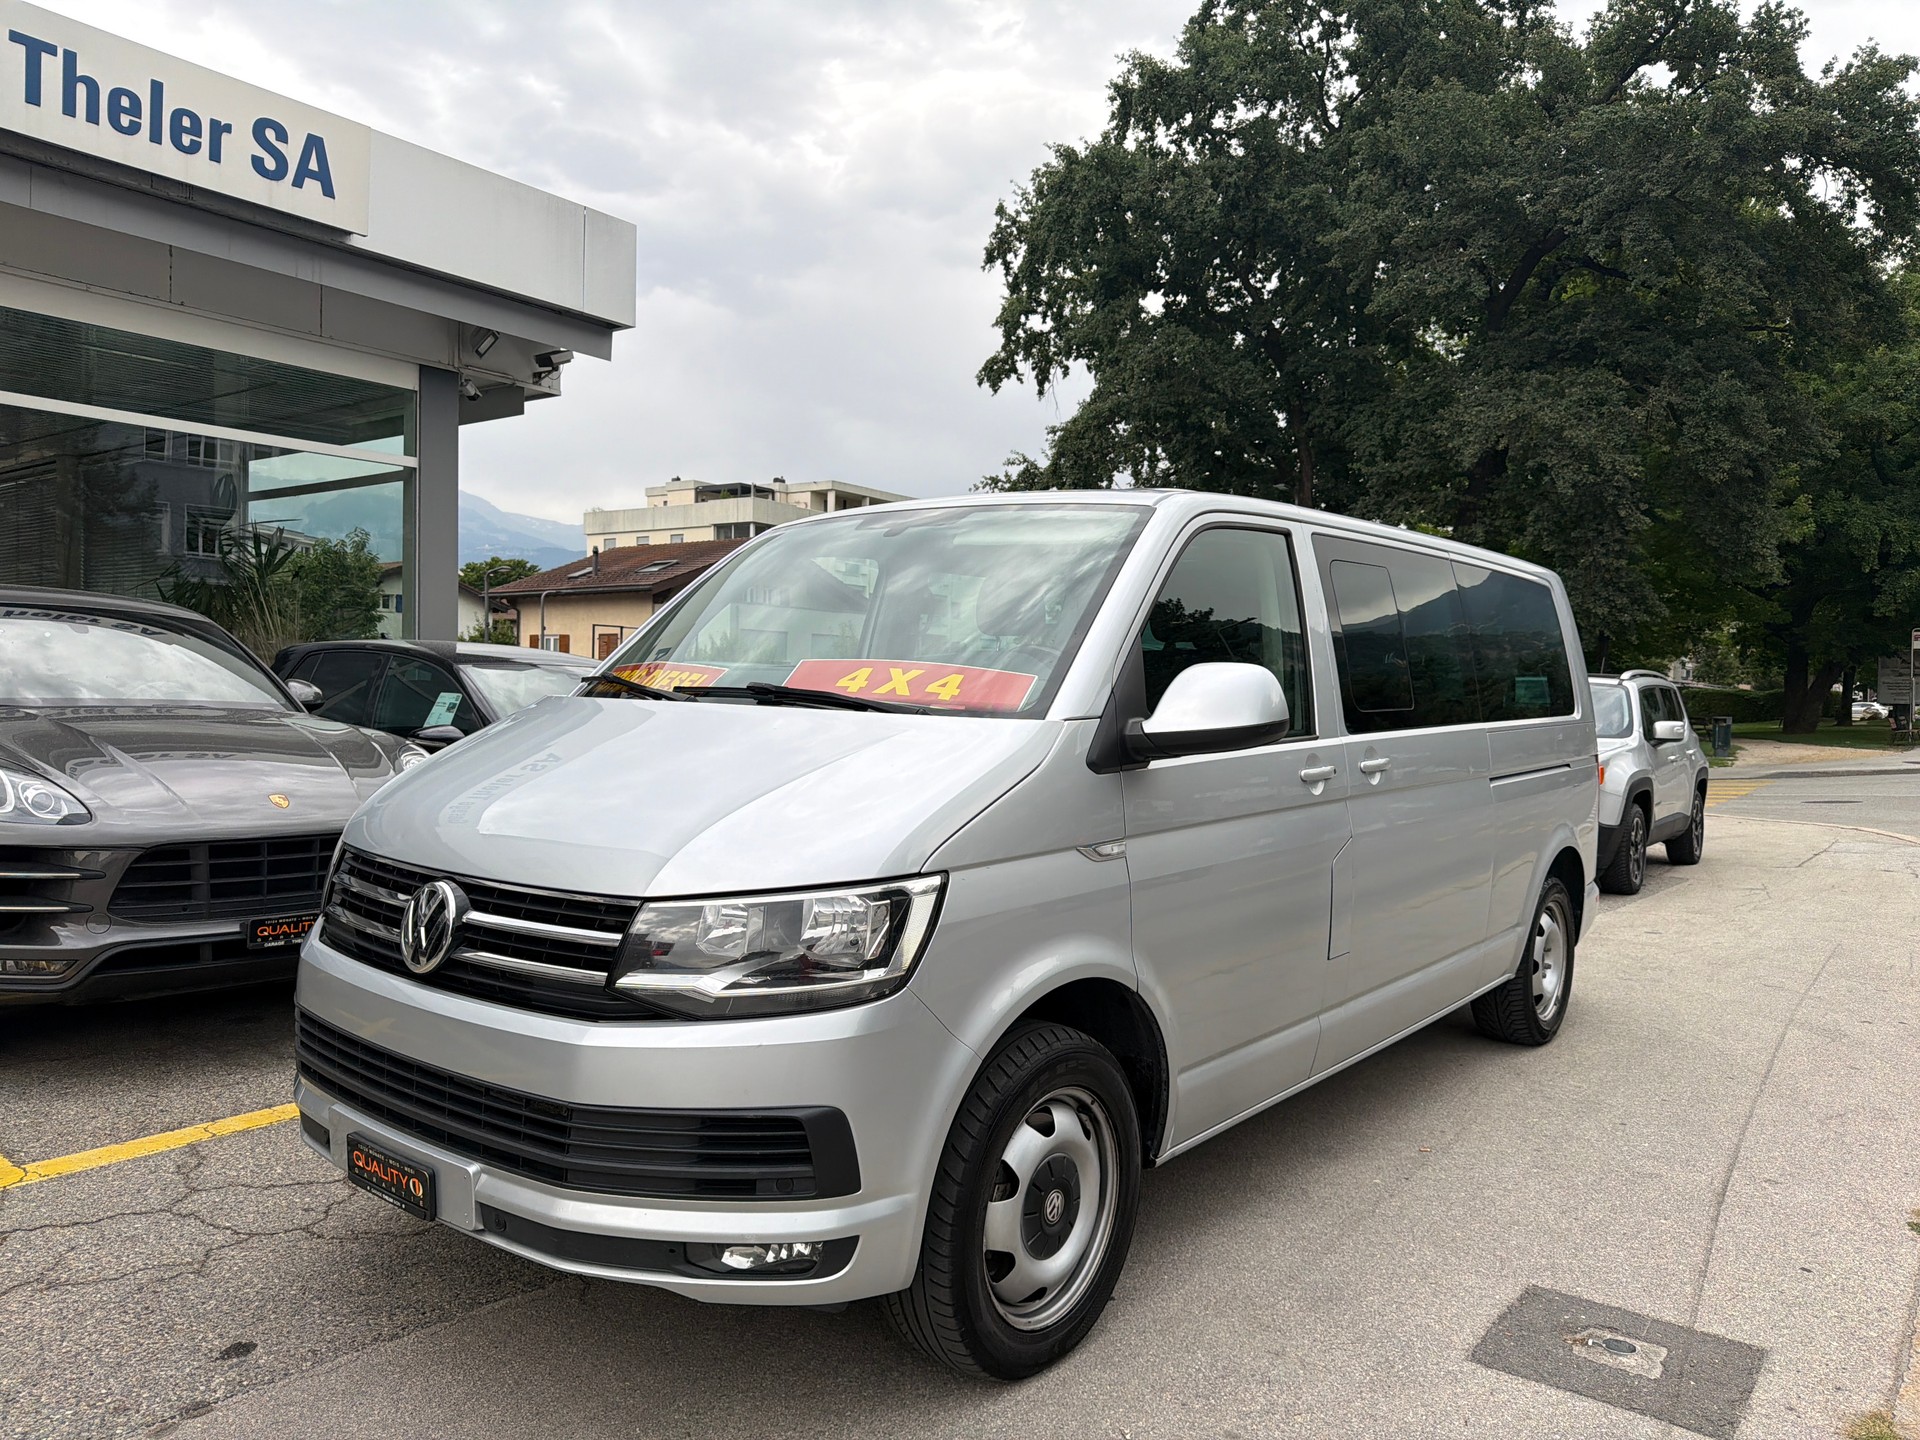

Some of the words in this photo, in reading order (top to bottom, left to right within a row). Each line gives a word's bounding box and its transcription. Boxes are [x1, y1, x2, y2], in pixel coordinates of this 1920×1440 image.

[8, 28, 232, 164] Theler
[250, 117, 336, 200] SA
[257, 921, 314, 936] QUALIT
